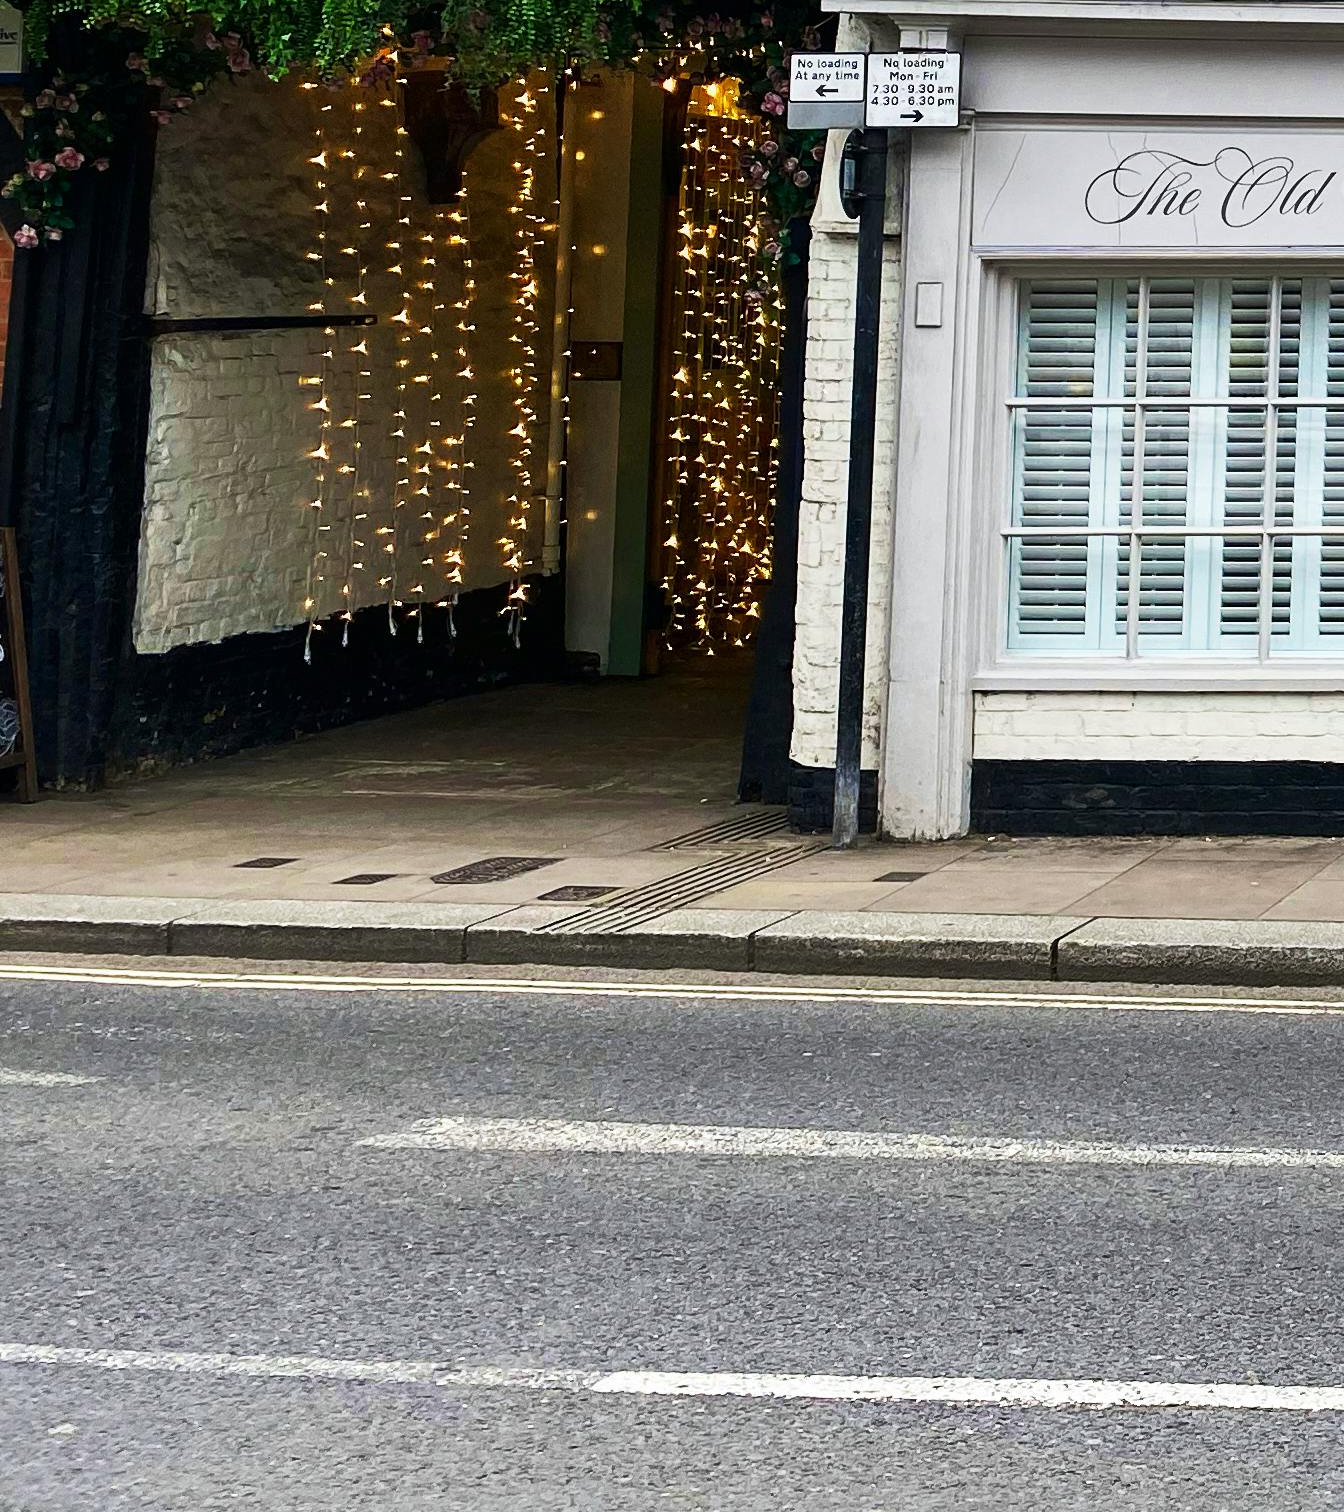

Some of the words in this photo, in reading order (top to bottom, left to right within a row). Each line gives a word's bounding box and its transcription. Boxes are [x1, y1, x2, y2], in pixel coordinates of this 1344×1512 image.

[797, 58, 813, 68] No
[817, 58, 858, 70] loading
[883, 58, 899, 68] No
[903, 57, 944, 69] loading
[795, 70, 808, 80] At
[812, 72, 831, 81] any
[836, 70, 860, 80] time
[889, 71, 914, 81] Mon
[923, 71, 938, 81] Fri
[907, 83, 935, 94] 9.30
[937, 86, 954, 94] am
[908, 95, 935, 106] 6.30
[937, 98, 955, 107] pm
[1085, 149, 1222, 225] The
[1214, 146, 1338, 228] Old
